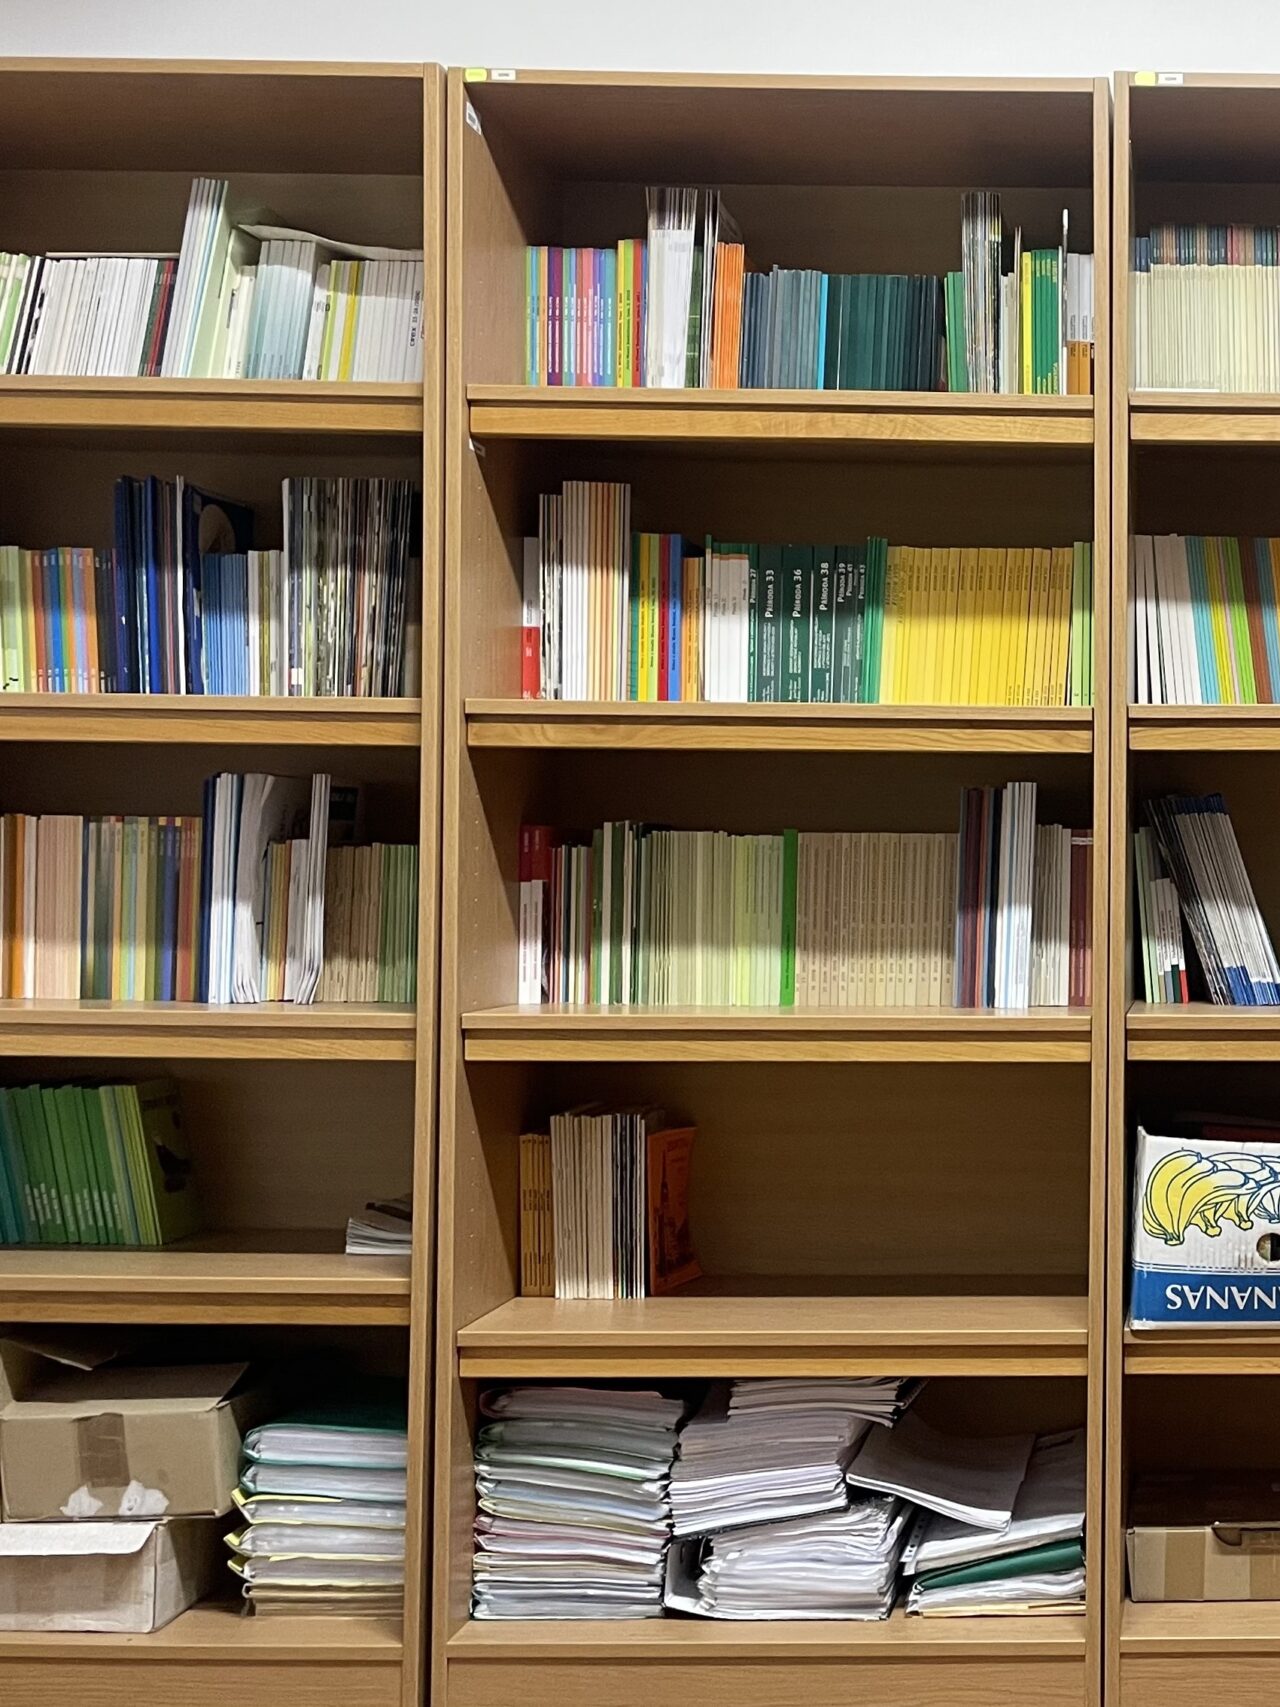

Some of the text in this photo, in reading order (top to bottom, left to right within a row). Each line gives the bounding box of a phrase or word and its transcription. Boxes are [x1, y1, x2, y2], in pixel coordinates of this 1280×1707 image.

[765, 569, 774, 582] 33
[793, 568, 802, 582] 36
[820, 562, 829, 576] 38
